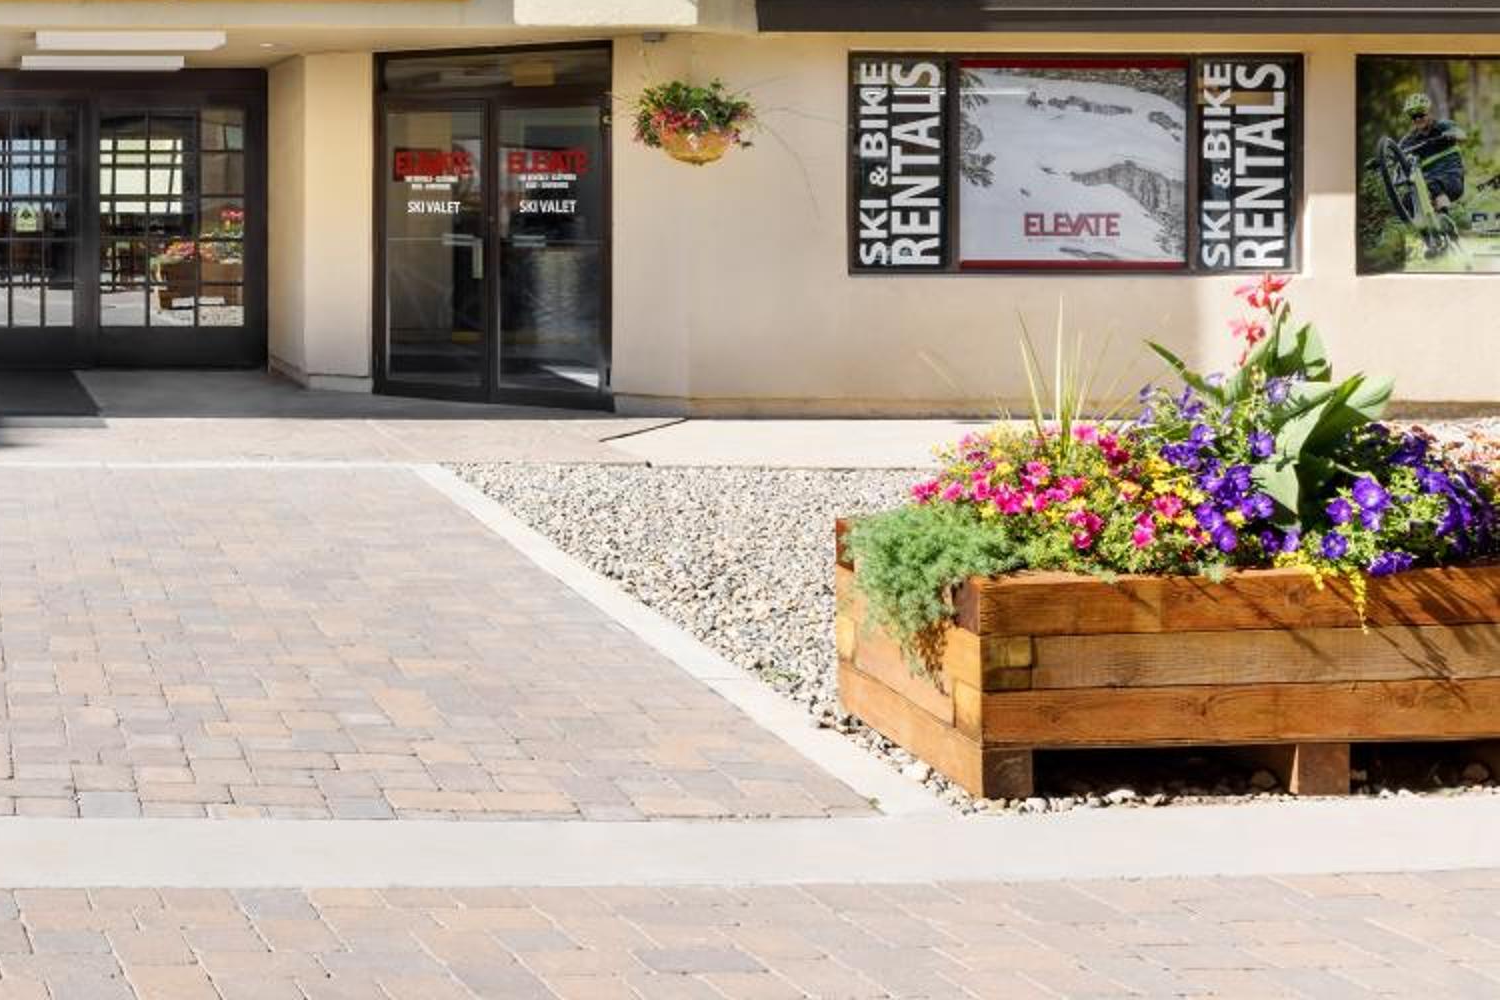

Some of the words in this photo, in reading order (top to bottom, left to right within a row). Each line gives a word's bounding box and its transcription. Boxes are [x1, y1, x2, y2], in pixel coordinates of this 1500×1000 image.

[859, 62, 888, 158] BIKE
[1203, 63, 1231, 159] BIKE
[869, 167, 888, 186] &
[891, 62, 940, 265] RENTALS
[1212, 167, 1231, 188] &
[1235, 63, 1285, 267] RENTALS
[407, 201, 425, 214] SKI
[426, 201, 461, 214] VALET
[519, 199, 538, 213] SKI
[539, 199, 577, 213] VALET
[859, 199, 888, 265] SKI
[1024, 212, 1121, 237] ELEVATE
[1202, 200, 1231, 267] SKI
